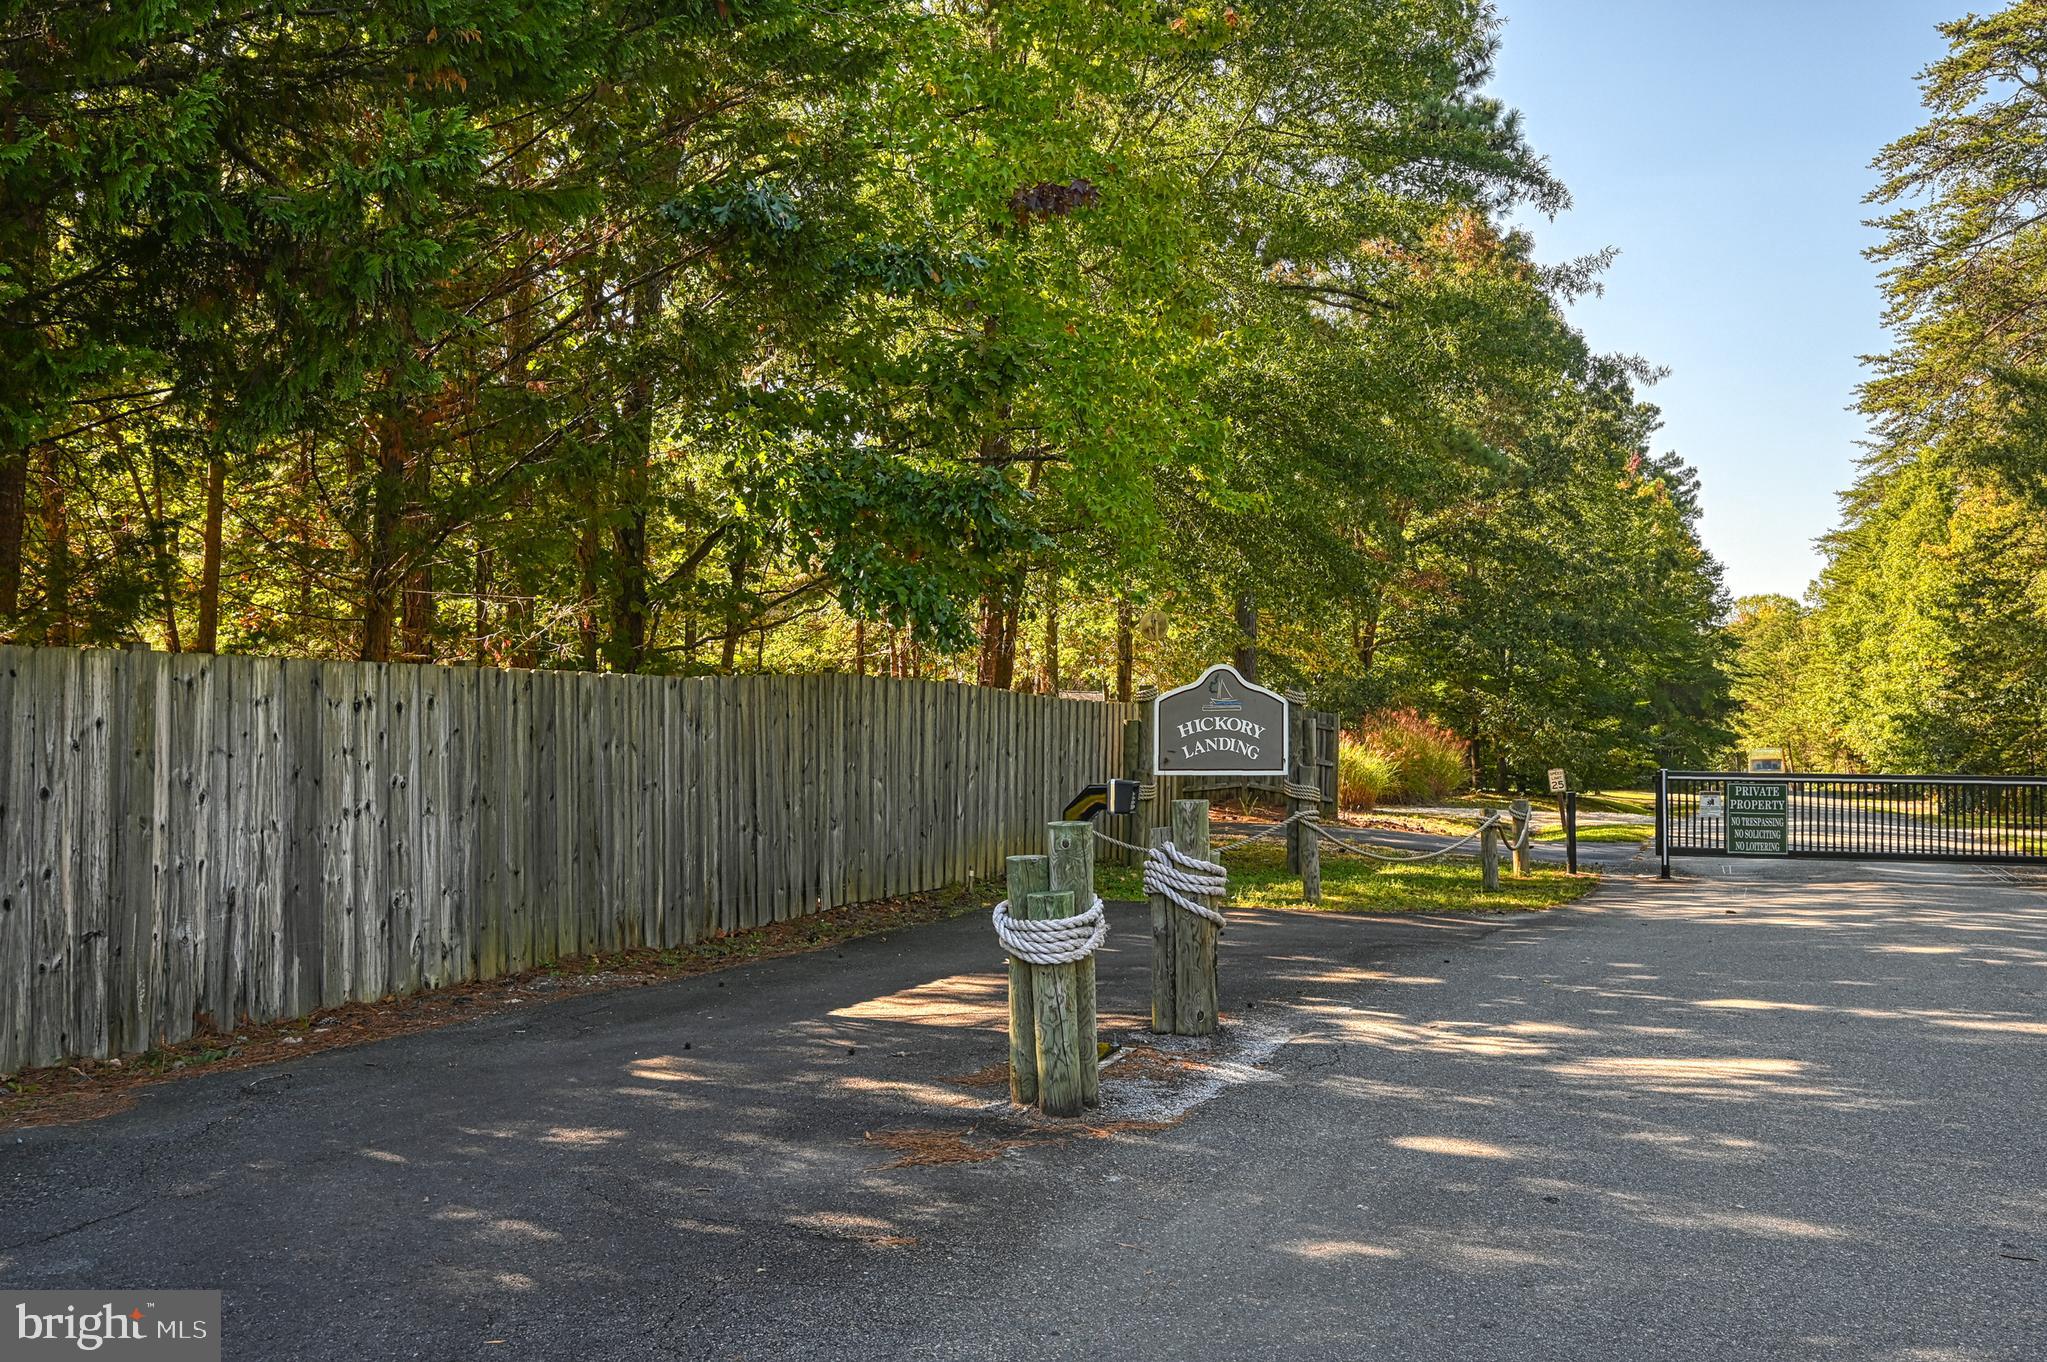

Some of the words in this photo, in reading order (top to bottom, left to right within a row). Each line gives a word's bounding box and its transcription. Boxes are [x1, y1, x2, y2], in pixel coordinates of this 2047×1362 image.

[1177, 717, 1266, 739] HICKORY
[1181, 737, 1260, 760] LANDING
[1552, 781, 1564, 789] 25
[1735, 786, 1780, 796] PRIVATE
[1730, 800, 1785, 810] PROPERTY
[1731, 817, 1740, 826] NO
[1742, 817, 1784, 827] TRESPASSING
[1734, 829, 1743, 838] NO
[1745, 830, 1781, 839] SOLICITING
[1735, 842, 1745, 851] NO
[1746, 842, 1780, 851] LOITERING
